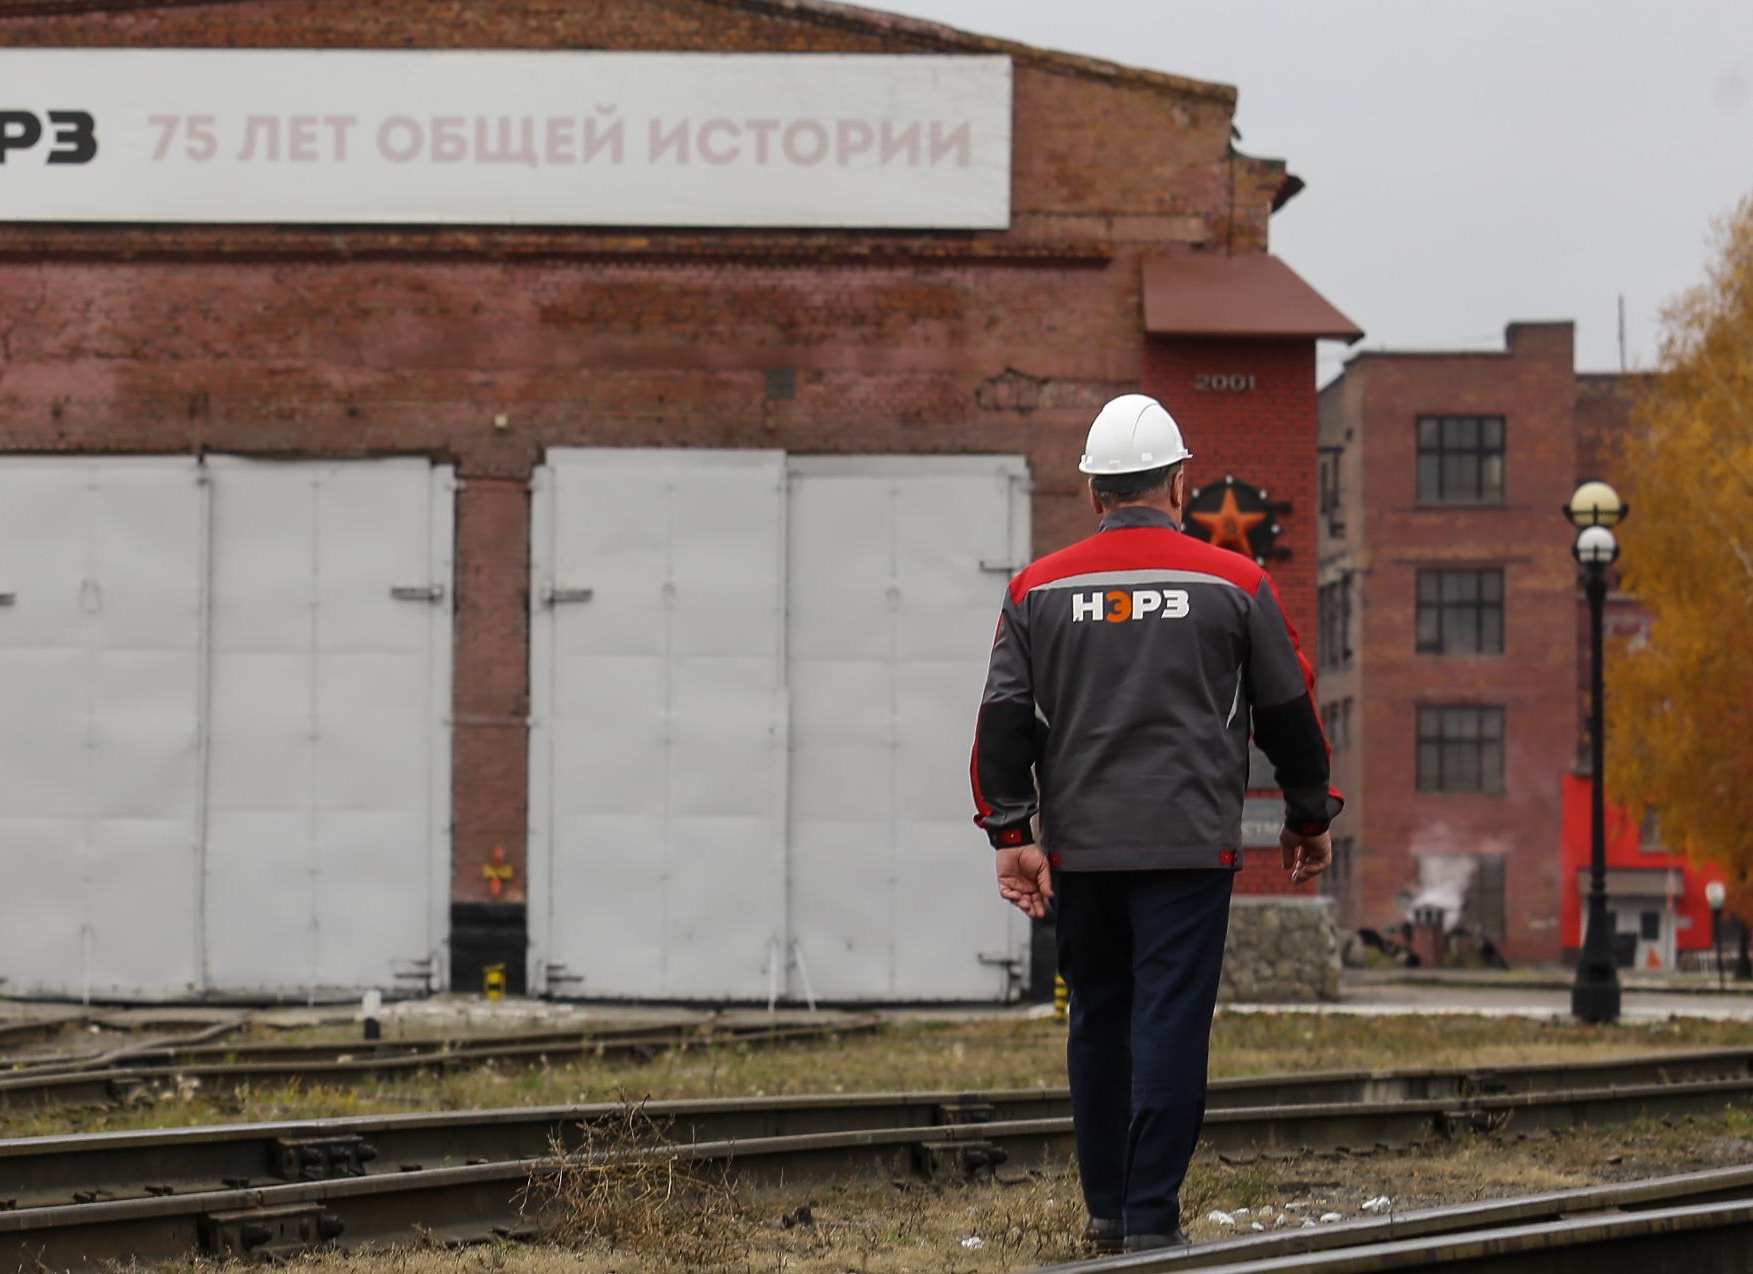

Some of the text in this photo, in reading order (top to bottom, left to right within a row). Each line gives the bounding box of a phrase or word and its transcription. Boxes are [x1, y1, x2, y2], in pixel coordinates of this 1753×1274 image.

[147, 114, 218, 163] 75
[235, 114, 358, 163] ЛЕТ
[375, 103, 626, 168] ОБЩЕЙ
[648, 116, 972, 168] ИСТОРИИ
[1195, 373, 1256, 392] 2001
[1072, 589, 1190, 623] НЭРЗ
